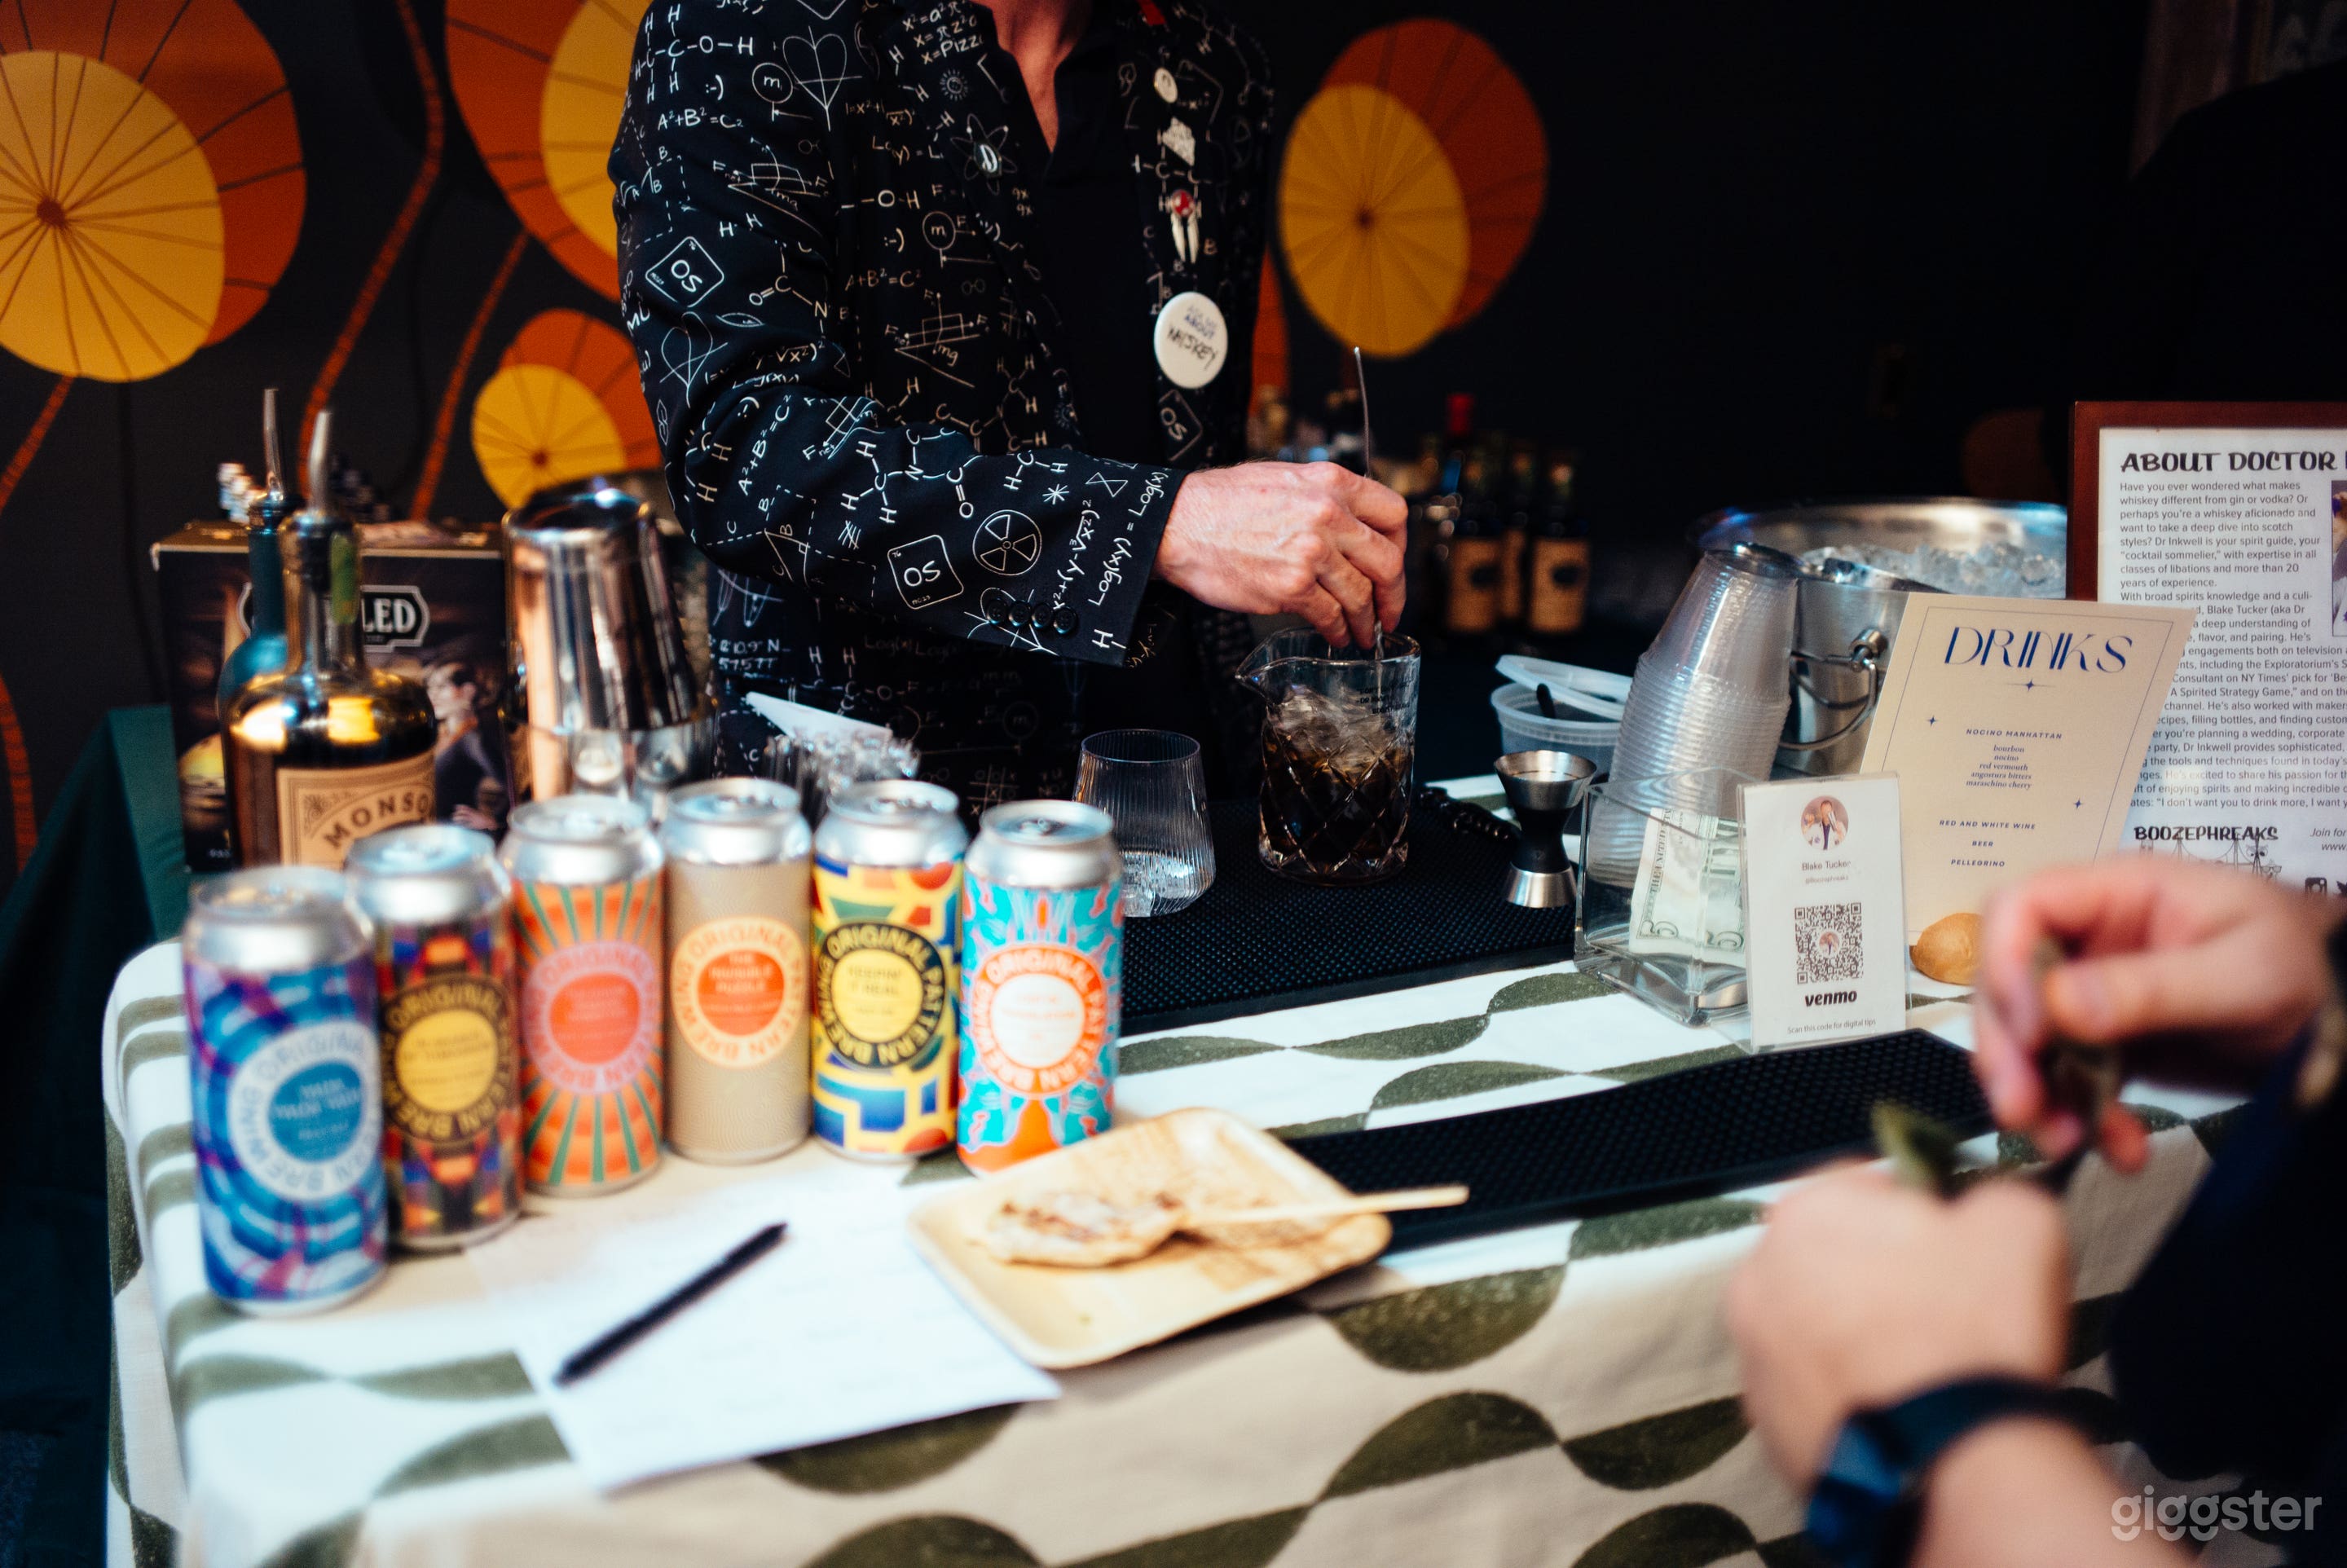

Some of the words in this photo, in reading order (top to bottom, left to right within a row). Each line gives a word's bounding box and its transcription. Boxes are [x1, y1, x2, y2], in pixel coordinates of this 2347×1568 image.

[2121, 452, 2222, 473] ABOUT
[2229, 451, 2337, 472] DOCTOR
[2120, 482, 2144, 491] Have
[2147, 484, 2164, 493] you
[2191, 482, 2239, 491] wondered
[2242, 481, 2266, 490] what
[2269, 481, 2301, 490] makes
[2120, 496, 2158, 507] whiskey
[2161, 496, 2201, 504] different
[2204, 495, 2226, 504] from
[2229, 495, 2244, 506] gin
[2259, 494, 2293, 504] vodka?
[2296, 494, 2308, 503] Or
[2120, 509, 2159, 521] perhaps
[2161, 509, 2191, 521] you're
[2203, 509, 2242, 520] whiskey
[2244, 509, 2295, 518] aficionado
[2297, 508, 2315, 518] and
[2120, 524, 2142, 532] want
[2147, 523, 2155, 532] to
[2159, 522, 2179, 531] take
[2191, 522, 2215, 534] deep
[2217, 522, 2238, 531] dive
[2241, 522, 2259, 531] into
[2261, 522, 2293, 531] scotch
[2120, 536, 2152, 548] styles?
[2155, 536, 2166, 546] Dr
[2169, 536, 2203, 545] Inkwell
[2205, 536, 2213, 545] is
[2215, 538, 2237, 548] your
[2239, 536, 2264, 548] spirit
[2266, 535, 2296, 547] guide,
[2298, 538, 2321, 547] your
[2120, 550, 2162, 560] "cocktail
[2164, 550, 2221, 561] sommelier,"
[2223, 550, 2244, 559] with
[2246, 549, 2291, 561] expertise
[2293, 549, 2302, 558] in
[2305, 549, 2316, 558] all
[2120, 564, 2155, 574] classes
[2157, 564, 2167, 574] of
[2170, 564, 2210, 573] libations
[2213, 564, 2231, 573] and
[2261, 563, 2283, 573] than
[2286, 563, 2299, 572] 20
[2120, 579, 2147, 589] years
[2149, 578, 2159, 587] of
[2161, 577, 2217, 588] experience.
[2120, 592, 2142, 601] With
[2144, 592, 2173, 601] broad
[2175, 592, 2204, 603] spirits
[2206, 591, 2260, 602] knowledge
[2262, 591, 2281, 600] and
[2292, 591, 2312, 600] culi-
[2207, 605, 2233, 614] Blake
[2236, 605, 2267, 614] Tucker
[2270, 605, 2291, 615] (aka
[2293, 605, 2305, 614] Dr
[2201, 619, 2226, 630] deep
[2228, 619, 2298, 630] understanding
[2301, 619, 2311, 628] of
[2198, 632, 2227, 643] flavor,
[2230, 632, 2248, 641] and
[2250, 632, 2287, 644] pairing.
[2289, 632, 2311, 641] He's
[1944, 626, 2133, 673] DRINKS
[2187, 647, 2254, 658] engagements
[2257, 645, 2279, 655] both
[2296, 645, 2343, 654] television
[2199, 659, 2244, 671] including
[2245, 659, 2261, 669] the
[2264, 659, 2339, 671] Exploratorium's
[2164, 701, 2204, 711] channel.
[2207, 701, 2229, 711] He's
[2230, 701, 2251, 711] also
[2253, 701, 2290, 710] worked
[2292, 701, 2313, 710] with
[2315, 701, 2347, 710] maker
[1966, 729, 2002, 737] NOCINO
[2006, 730, 2062, 739] MANHATTAN
[1993, 744, 2024, 752] bourbon
[2009, 781, 2032, 790] cherry
[2156, 798, 2164, 807] "I
[2166, 798, 2191, 807] don't
[2194, 799, 2217, 807] want
[2220, 799, 2238, 809] you
[2240, 799, 2250, 807] to
[2252, 798, 2277, 807] drink
[2280, 799, 2308, 808] more,
[2310, 798, 2314, 807] I
[2316, 799, 2340, 807] want
[324, 789, 431, 848] MONSO
[2133, 826, 2279, 840] BOOZEPHREAKS
[2310, 828, 2330, 837] Join
[2333, 827, 2347, 837] for
[1802, 862, 1822, 871] Blake
[1825, 860, 1851, 869] Tucker
[1951, 859, 2006, 867] PELLEGRINO
[827, 925, 931, 971] ORIGINAL
[1805, 991, 1857, 1007] venmo
[1804, 1024, 1816, 1033] this
[1817, 1023, 1833, 1031] code
[1843, 1019, 1864, 1028] digital
[1865, 1018, 1876, 1028] tips
